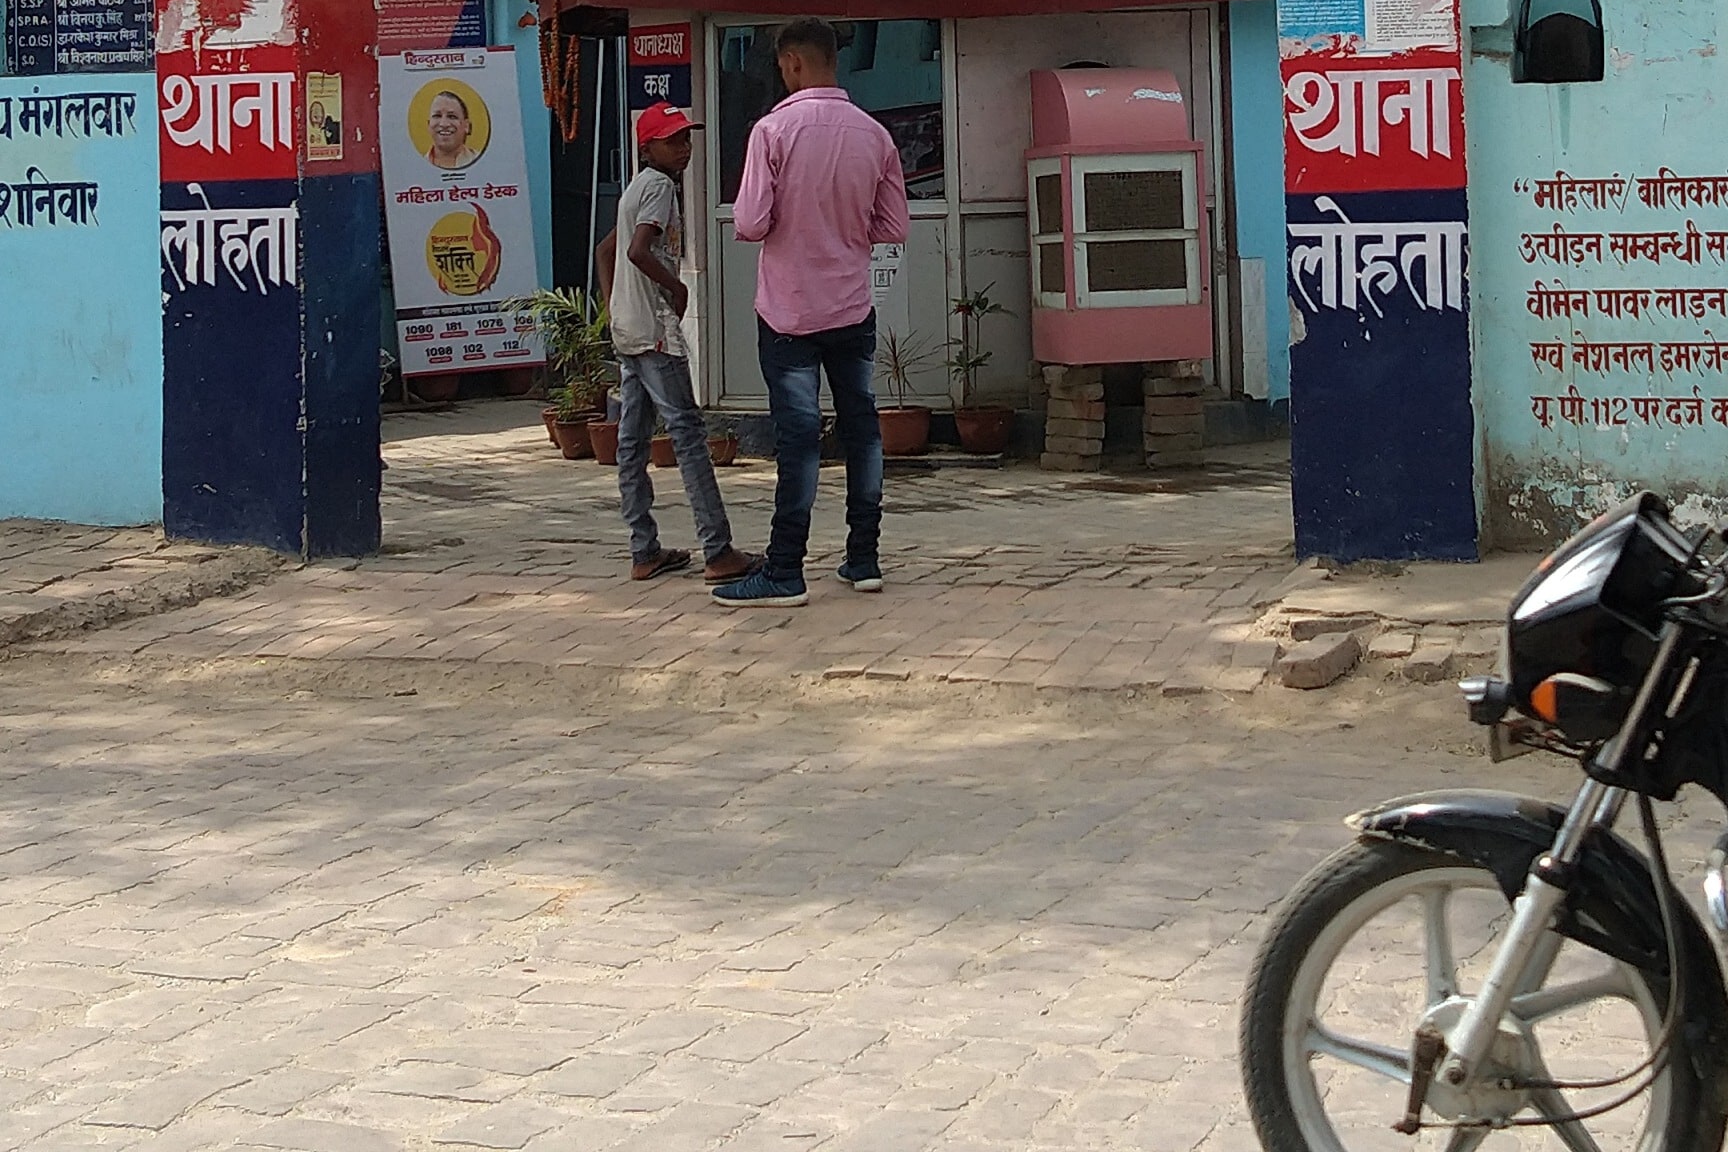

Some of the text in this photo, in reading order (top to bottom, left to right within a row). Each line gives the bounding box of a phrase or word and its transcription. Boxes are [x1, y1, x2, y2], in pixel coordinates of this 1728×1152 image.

[404, 51, 465, 67] हिन्दुस्तान
[634, 33, 684, 58] थानाध्यक्ष
[644, 74, 671, 100] कक्ष
[18, 86, 137, 138] मंगलवार
[161, 71, 296, 155] थाना
[1287, 68, 1460, 159] थाना
[0, 166, 99, 229] शनिवार
[396, 183, 518, 204] महिला हेल्प डेस्क
[161, 183, 299, 296] लोहता
[433, 247, 477, 277] शक्ति
[1288, 195, 1467, 318] लोहता
[1518, 222, 1604, 268] उत्पीड़न
[1608, 219, 1703, 266] सम्बन्धी
[1526, 279, 1591, 321] वीमेन
[1593, 289, 1654, 325] पावर
[463, 344, 483, 354] 102
[502, 340, 520, 350] 112
[1572, 330, 1656, 379] नेशनल
[1631, 398, 1663, 430] पर
[1665, 384, 1705, 430] दर्ज
